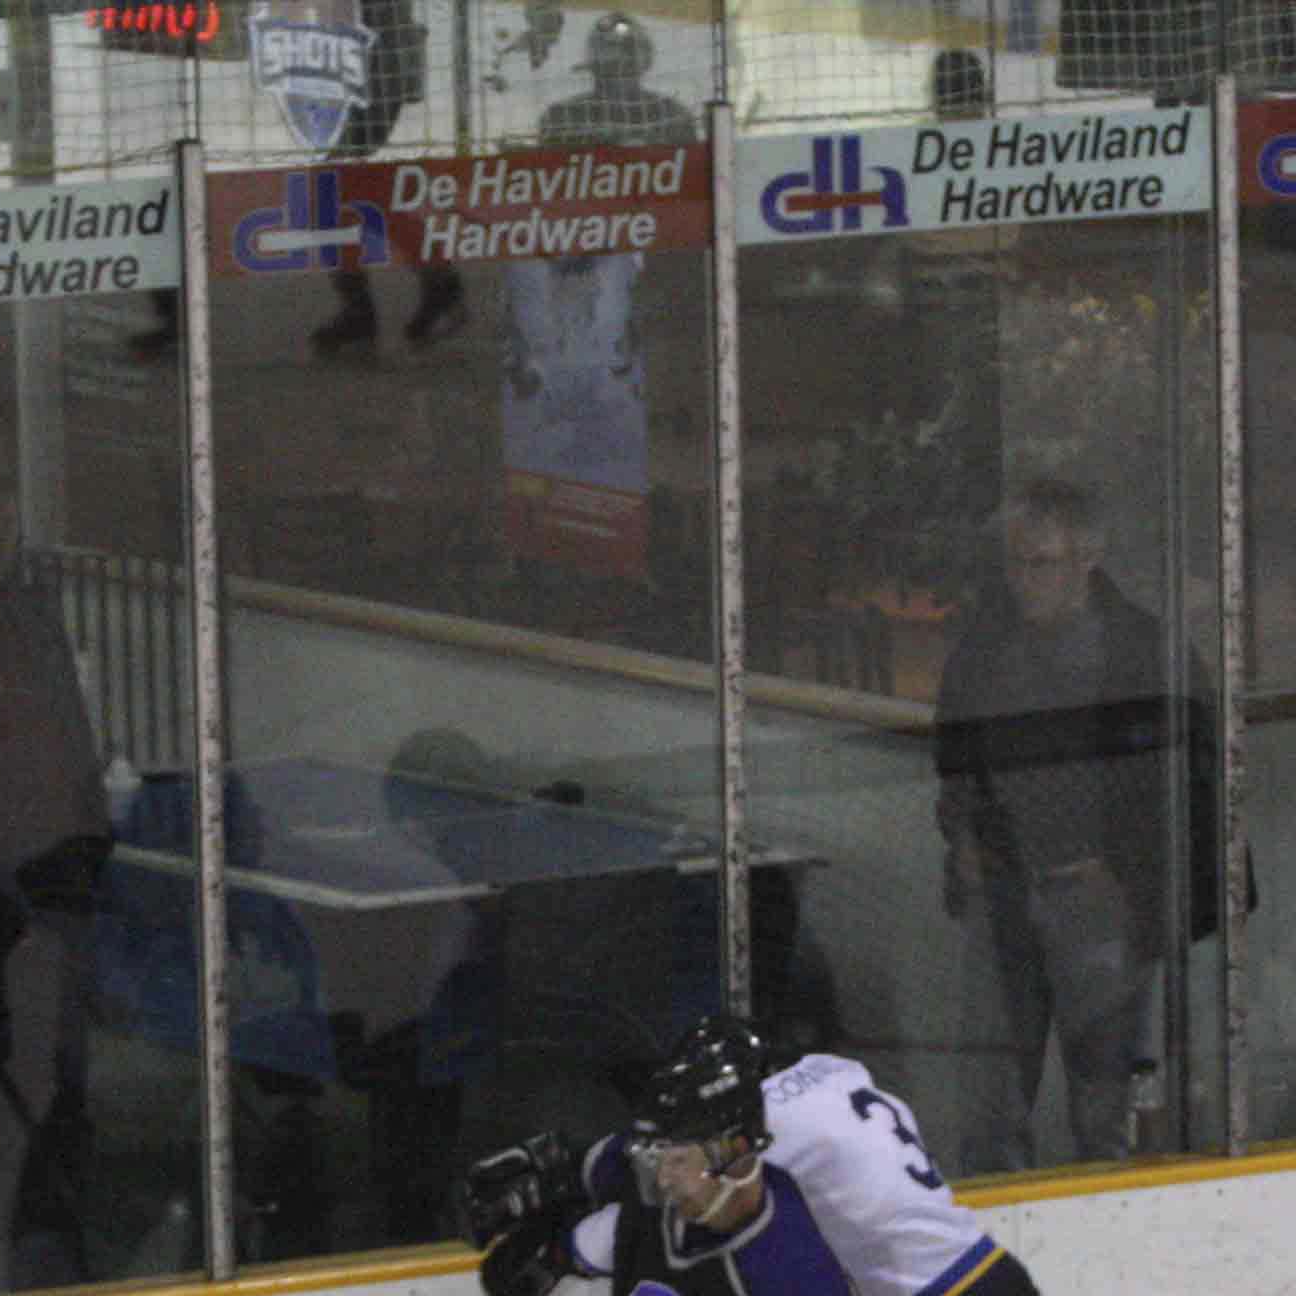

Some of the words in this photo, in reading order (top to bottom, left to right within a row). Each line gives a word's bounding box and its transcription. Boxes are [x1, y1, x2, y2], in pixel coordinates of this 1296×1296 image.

[261, 28, 365, 90] SHOTS
[911, 129, 974, 174] De
[985, 112, 1192, 167] Haviland
[390, 164, 457, 212] De
[468, 148, 687, 210] Haviland
[940, 172, 1165, 223] Hardware
[421, 210, 657, 262] Hardware
